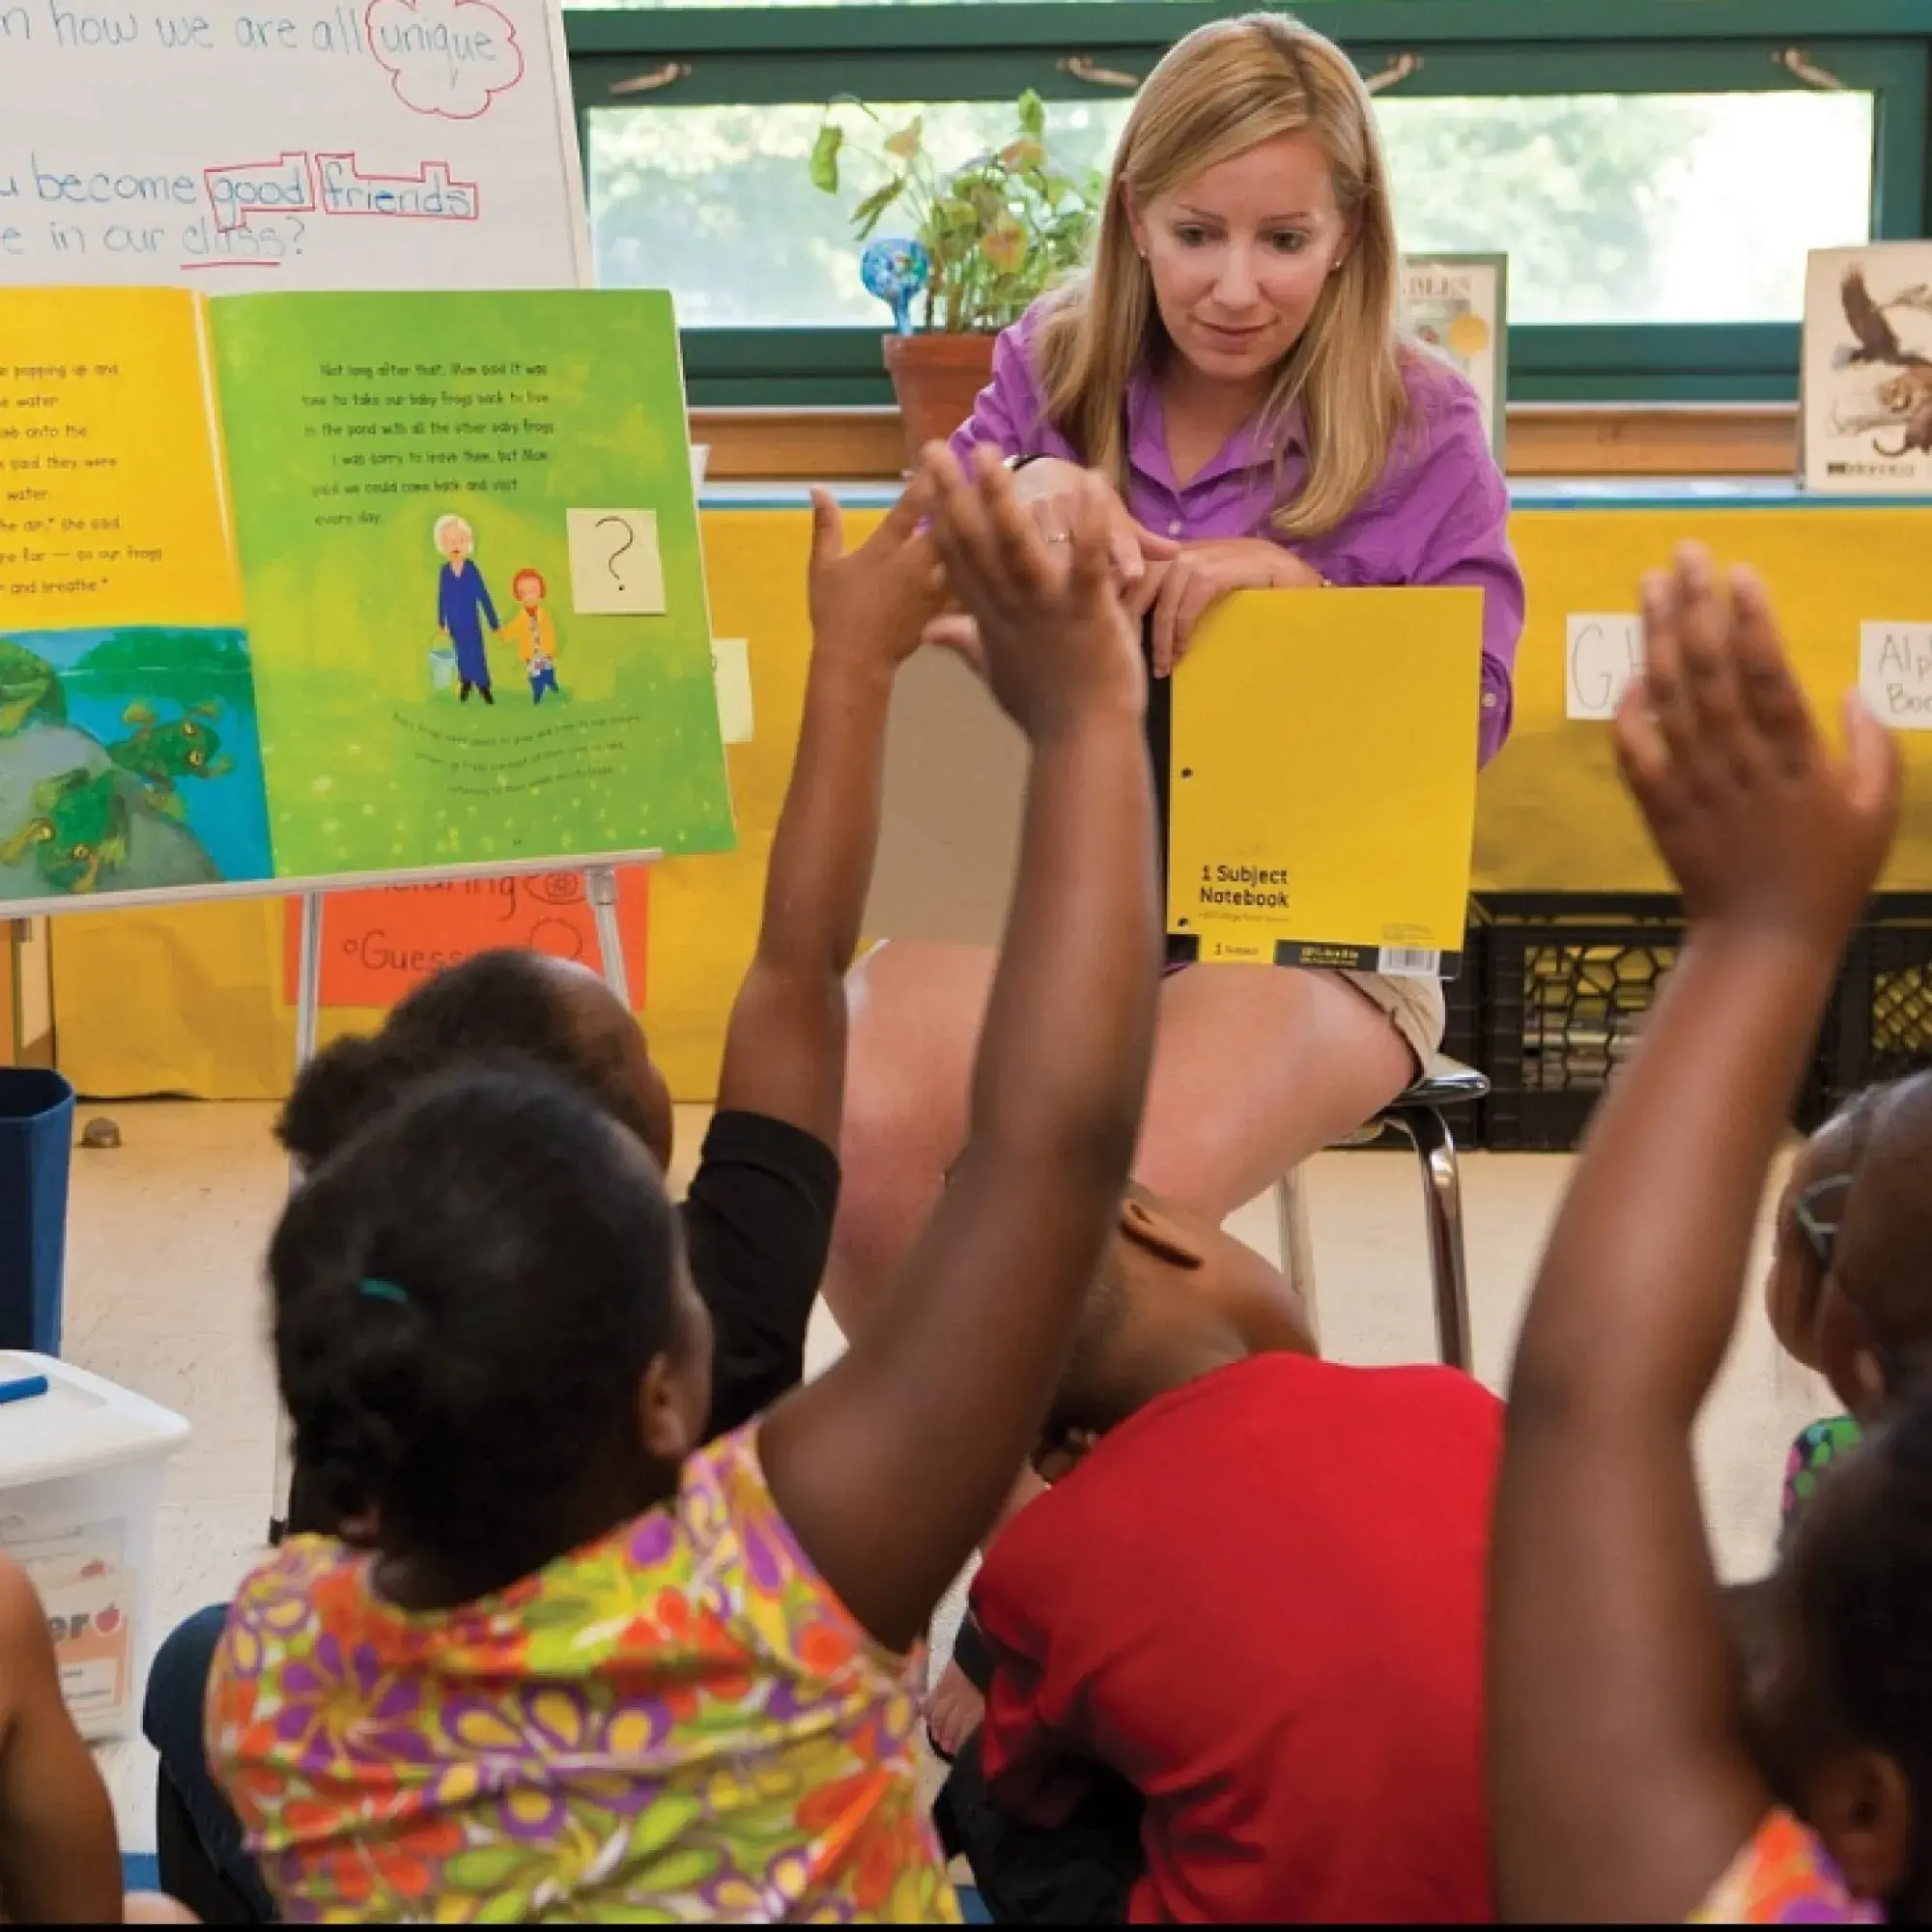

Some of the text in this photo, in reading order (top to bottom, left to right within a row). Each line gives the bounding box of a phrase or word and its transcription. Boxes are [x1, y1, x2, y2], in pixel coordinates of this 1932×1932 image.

[49, 0, 139, 47] how
[155, 15, 214, 48] we
[235, 15, 298, 48] are
[313, 4, 362, 55] all
[381, 17, 496, 89] unique
[31, 150, 197, 204] become
[213, 168, 303, 230] good
[326, 160, 470, 216] friends
[50, 220, 85, 253] in
[103, 224, 165, 253] our
[1878, 633, 1932, 684] Alp
[1200, 886, 1290, 908] Notebook
[1202, 865, 1289, 887] 1 Subject
